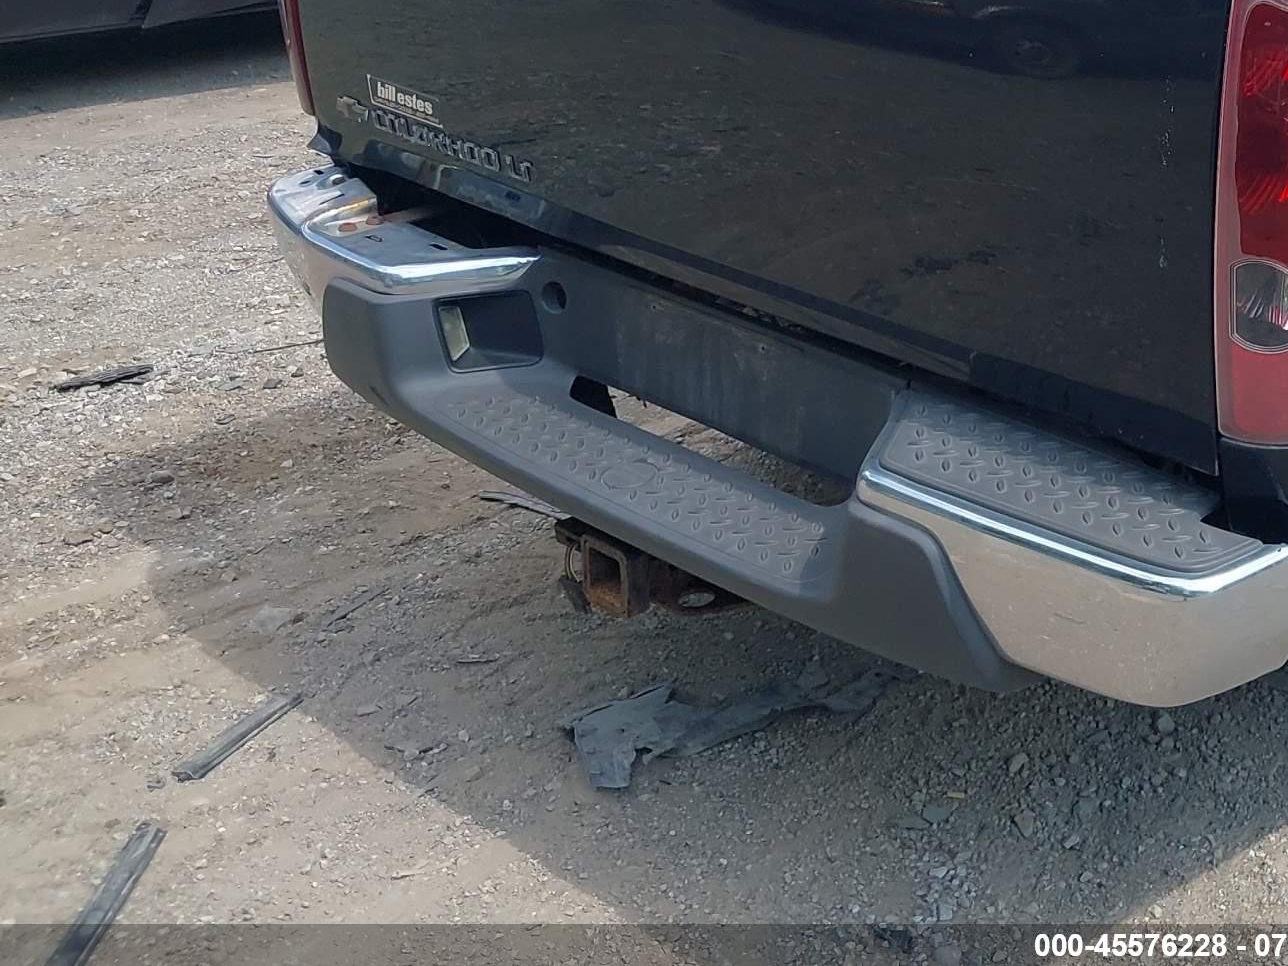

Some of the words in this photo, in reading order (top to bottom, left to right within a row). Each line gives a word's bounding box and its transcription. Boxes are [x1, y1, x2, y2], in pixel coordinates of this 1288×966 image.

[377, 81, 396, 103] bill
[397, 92, 433, 115] estes
[372, 109, 501, 172] COLORADO
